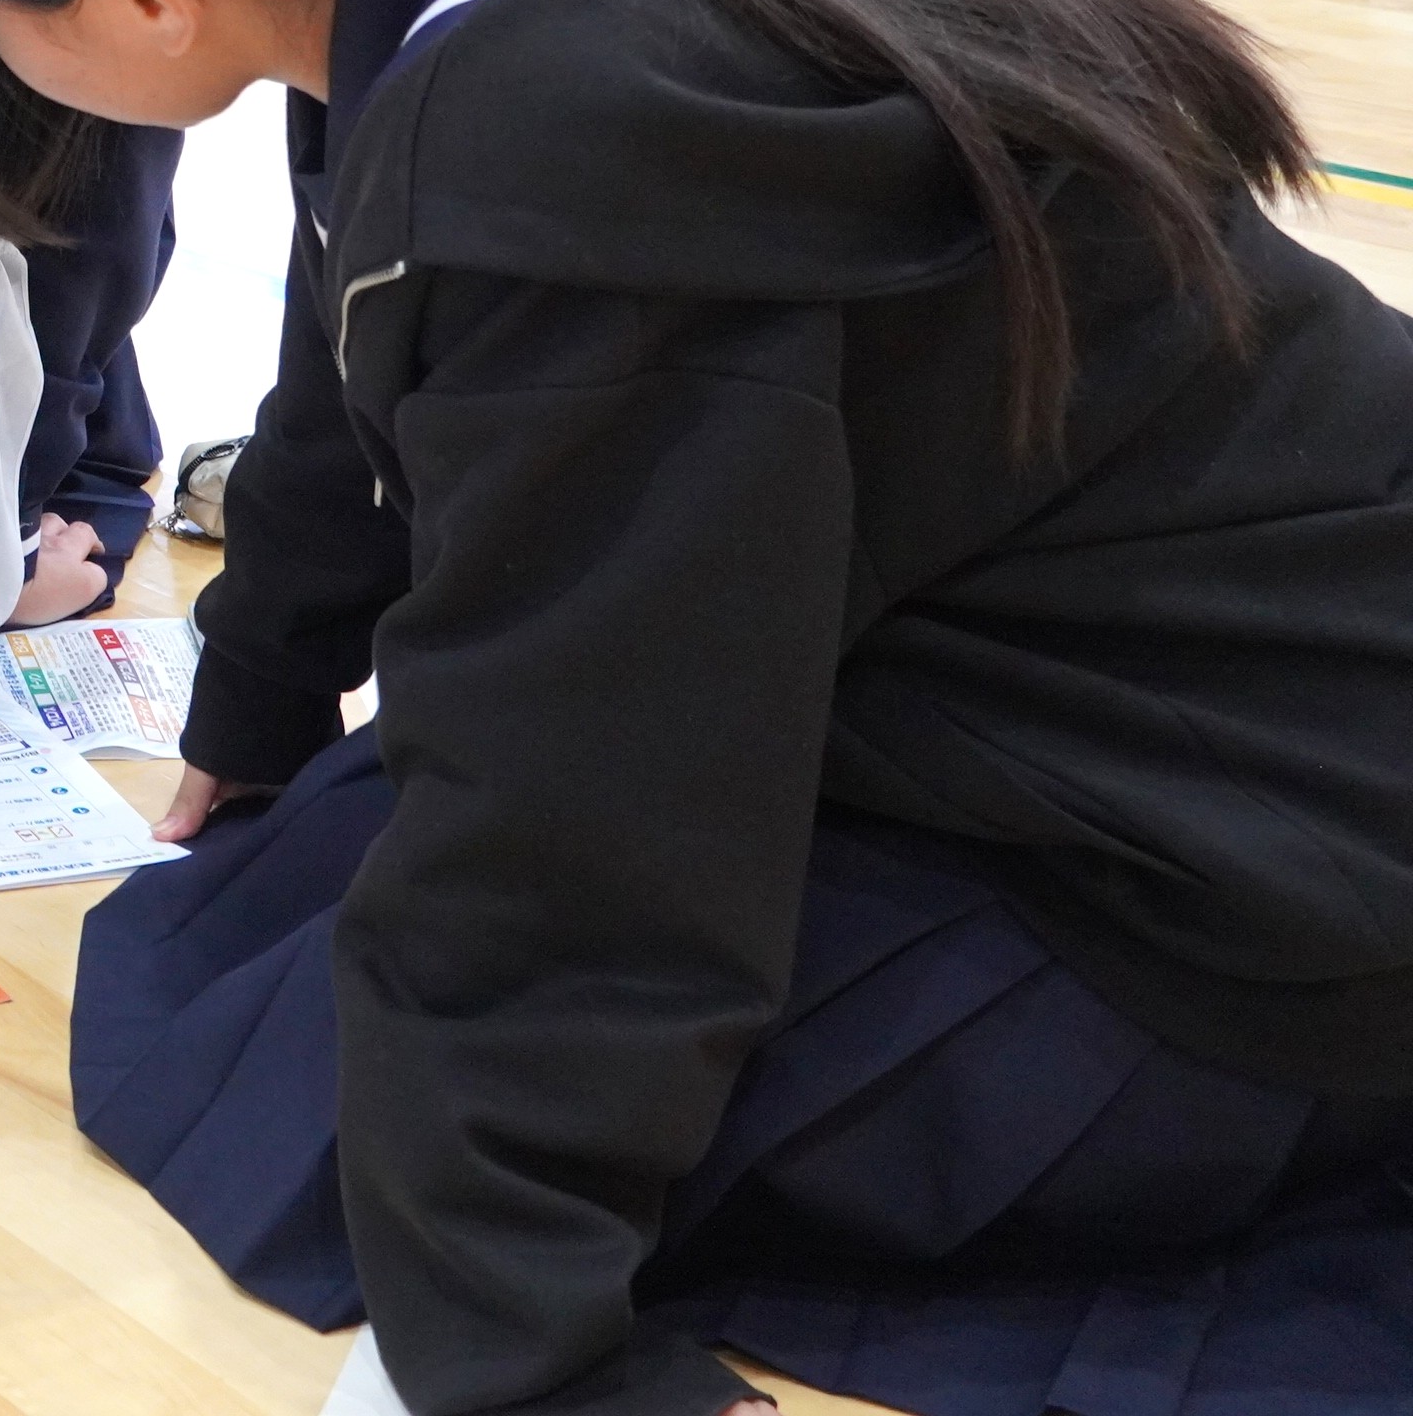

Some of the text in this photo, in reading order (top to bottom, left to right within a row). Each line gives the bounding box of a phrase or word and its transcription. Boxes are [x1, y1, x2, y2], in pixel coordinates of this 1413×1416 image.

[41, 706, 63, 725] サイエンス
